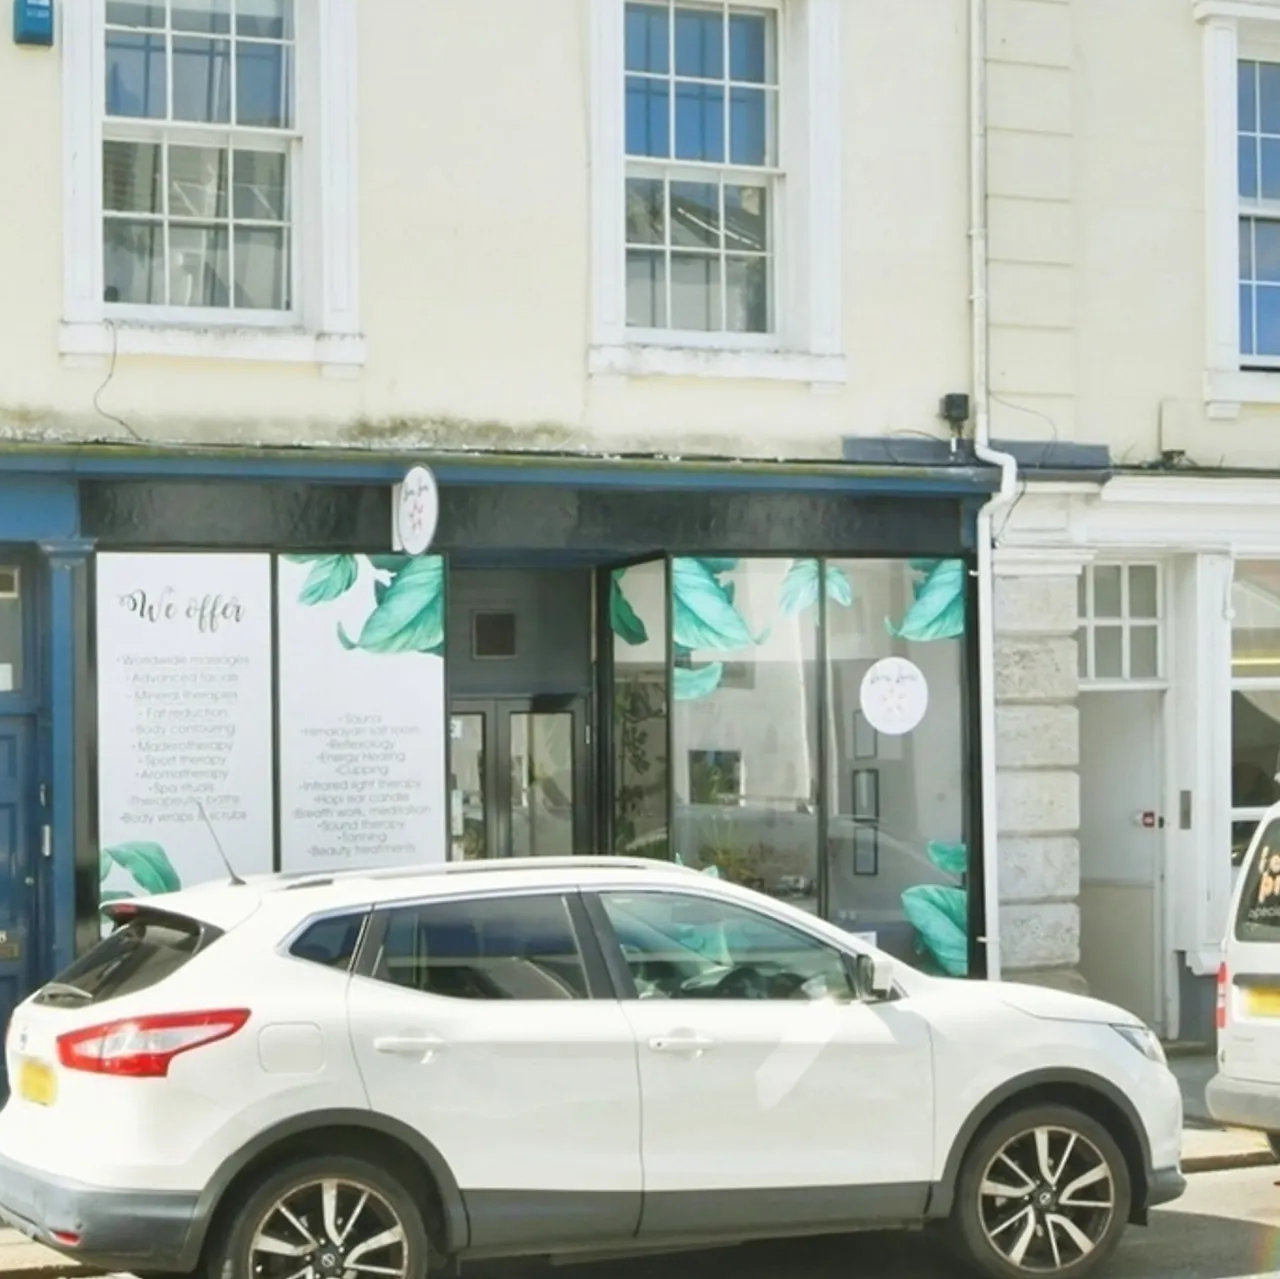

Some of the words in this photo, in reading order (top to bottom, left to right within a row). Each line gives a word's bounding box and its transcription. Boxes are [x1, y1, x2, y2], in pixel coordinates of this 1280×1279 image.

[117, 585, 177, 623] We
[185, 594, 245, 633] offer
[132, 672, 197, 683] Advanced
